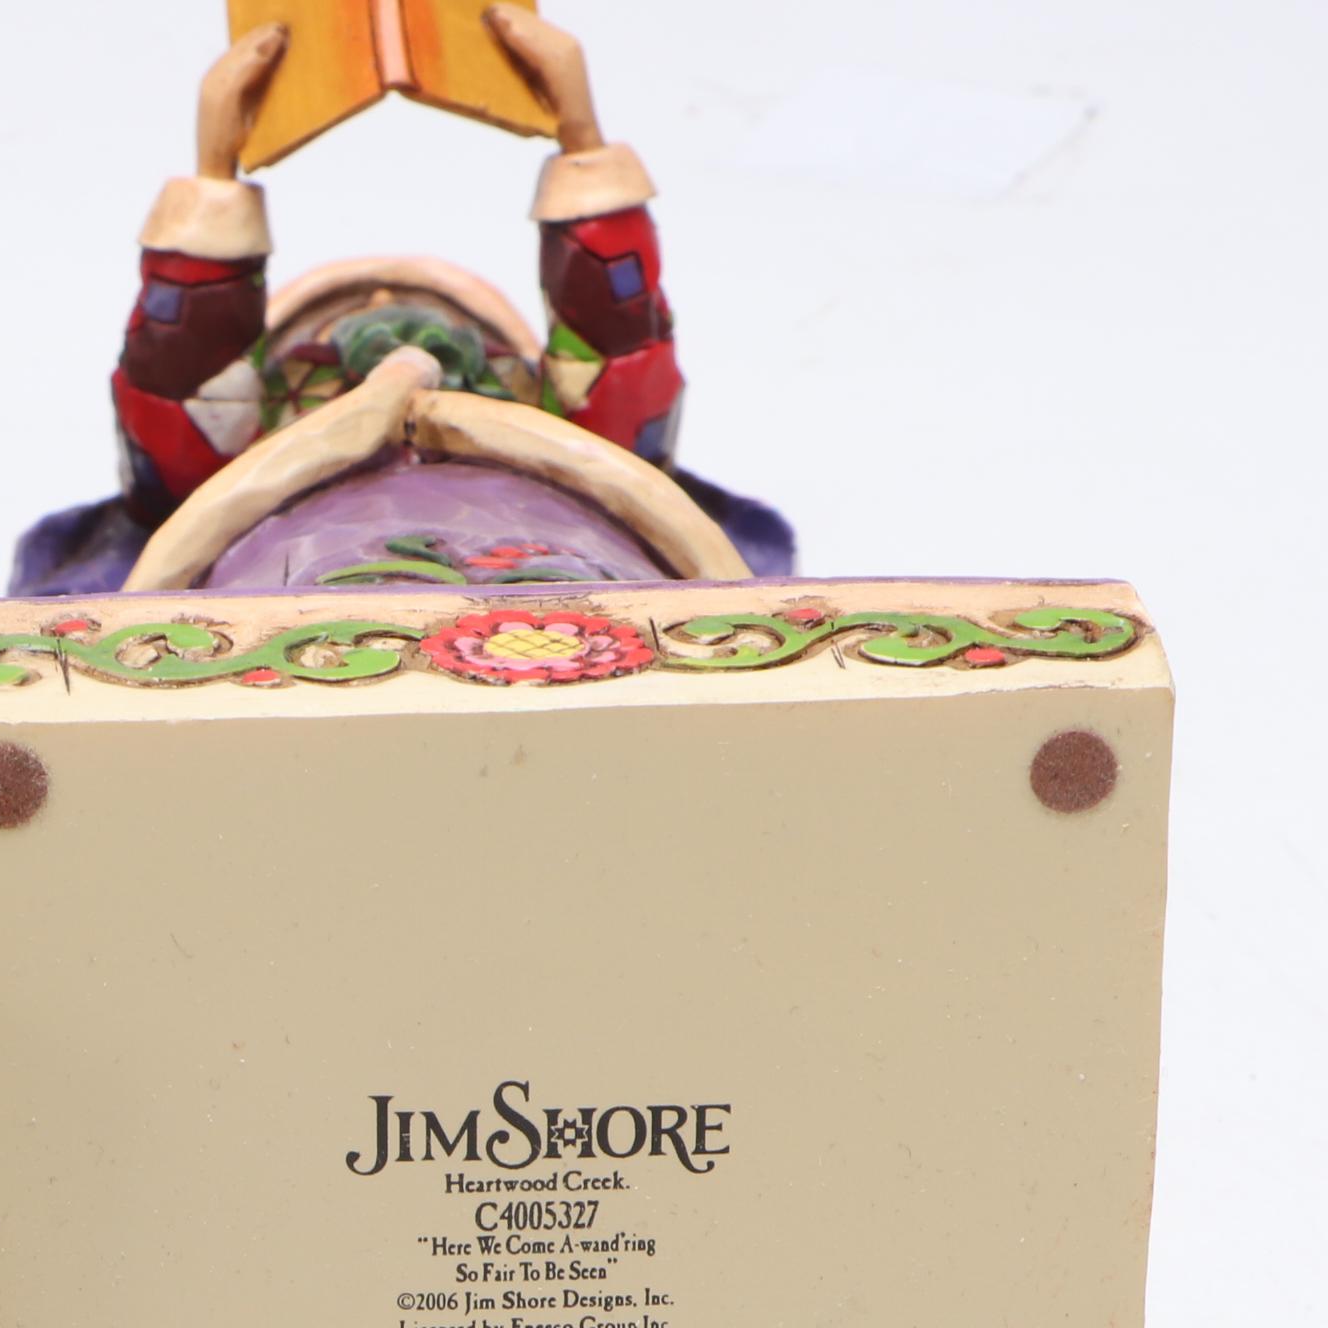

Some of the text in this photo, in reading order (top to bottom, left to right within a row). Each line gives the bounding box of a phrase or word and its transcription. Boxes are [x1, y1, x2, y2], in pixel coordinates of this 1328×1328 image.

[445, 1171, 630, 1193] Heartwood Creek.
[475, 1200, 599, 1230] C4005327
[477, 1236, 501, 1254] We
[506, 1235, 555, 1254] Come
[456, 1264, 478, 1282] So
[482, 1263, 515, 1282] Fair
[520, 1262, 541, 1281] To
[545, 1262, 565, 1280] Be
[397, 1292, 458, 1311] ©2006
[464, 1291, 496, 1316] Jim
[502, 1290, 557, 1309] Shore
[644, 1288, 674, 1306] Inc.
